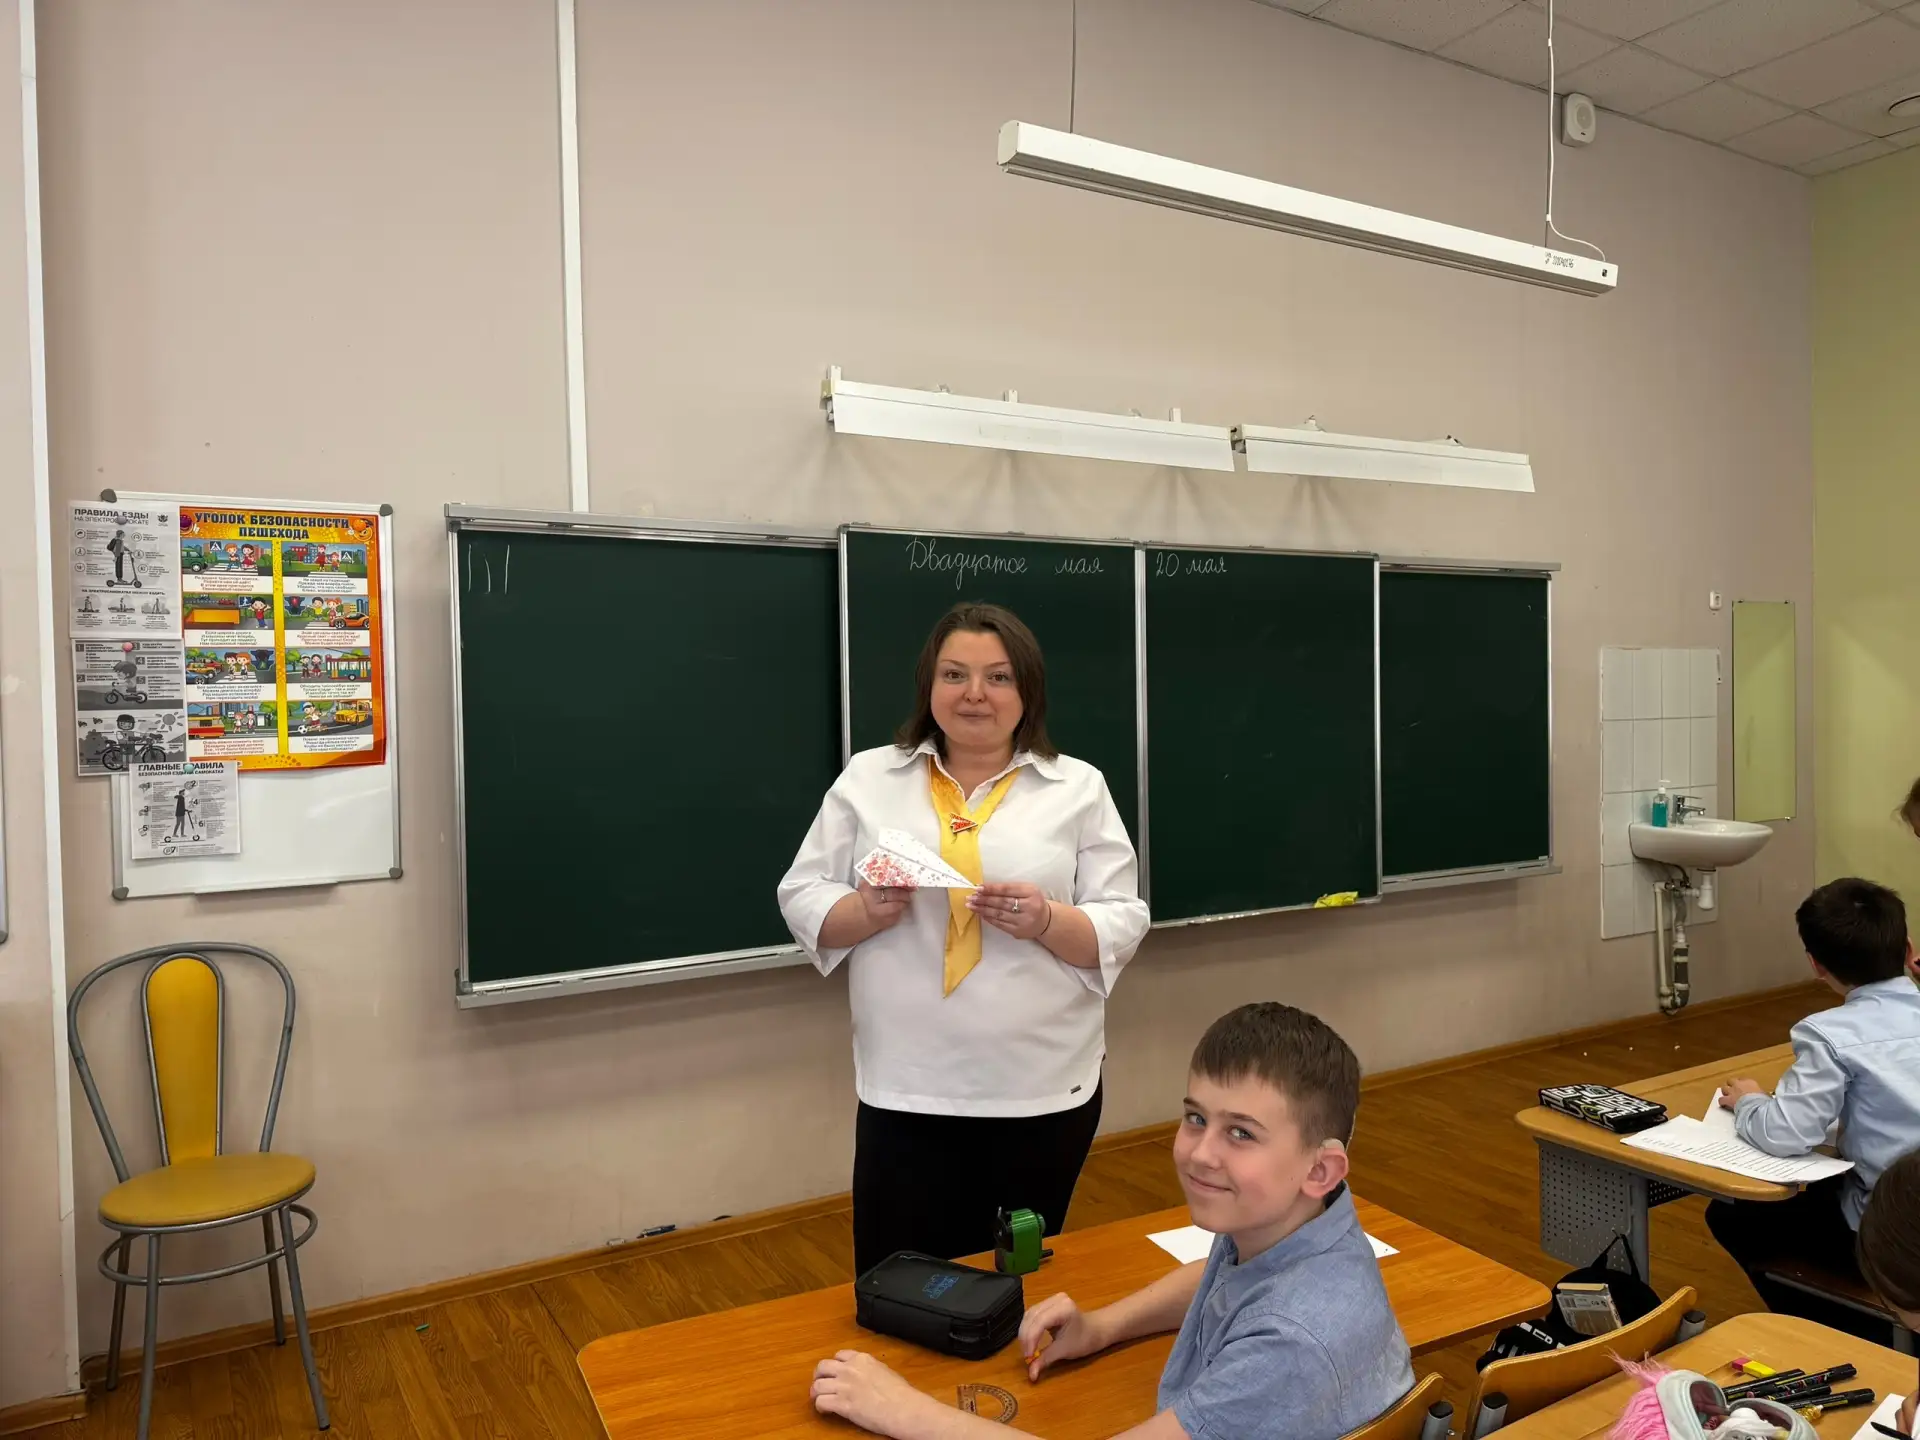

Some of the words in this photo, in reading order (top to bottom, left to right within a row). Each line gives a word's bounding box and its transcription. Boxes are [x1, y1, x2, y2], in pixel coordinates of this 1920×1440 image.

[74, 508, 119, 517] ПРАВИЛА
[122, 511, 149, 520] ЕЗДЫ
[194, 512, 246, 525] УГОЛОК
[250, 514, 350, 529] БЕЗОПАСНОСТИ
[239, 526, 310, 540] ПЕШЕХОДА
[905, 536, 1028, 591] Двадцатое
[1055, 556, 1104, 575] мая
[1156, 551, 1180, 578] 20
[1185, 556, 1228, 575] мая
[138, 763, 181, 771] ГЛАВНЫЕ
[183, 761, 224, 771] ПАВИЛА
